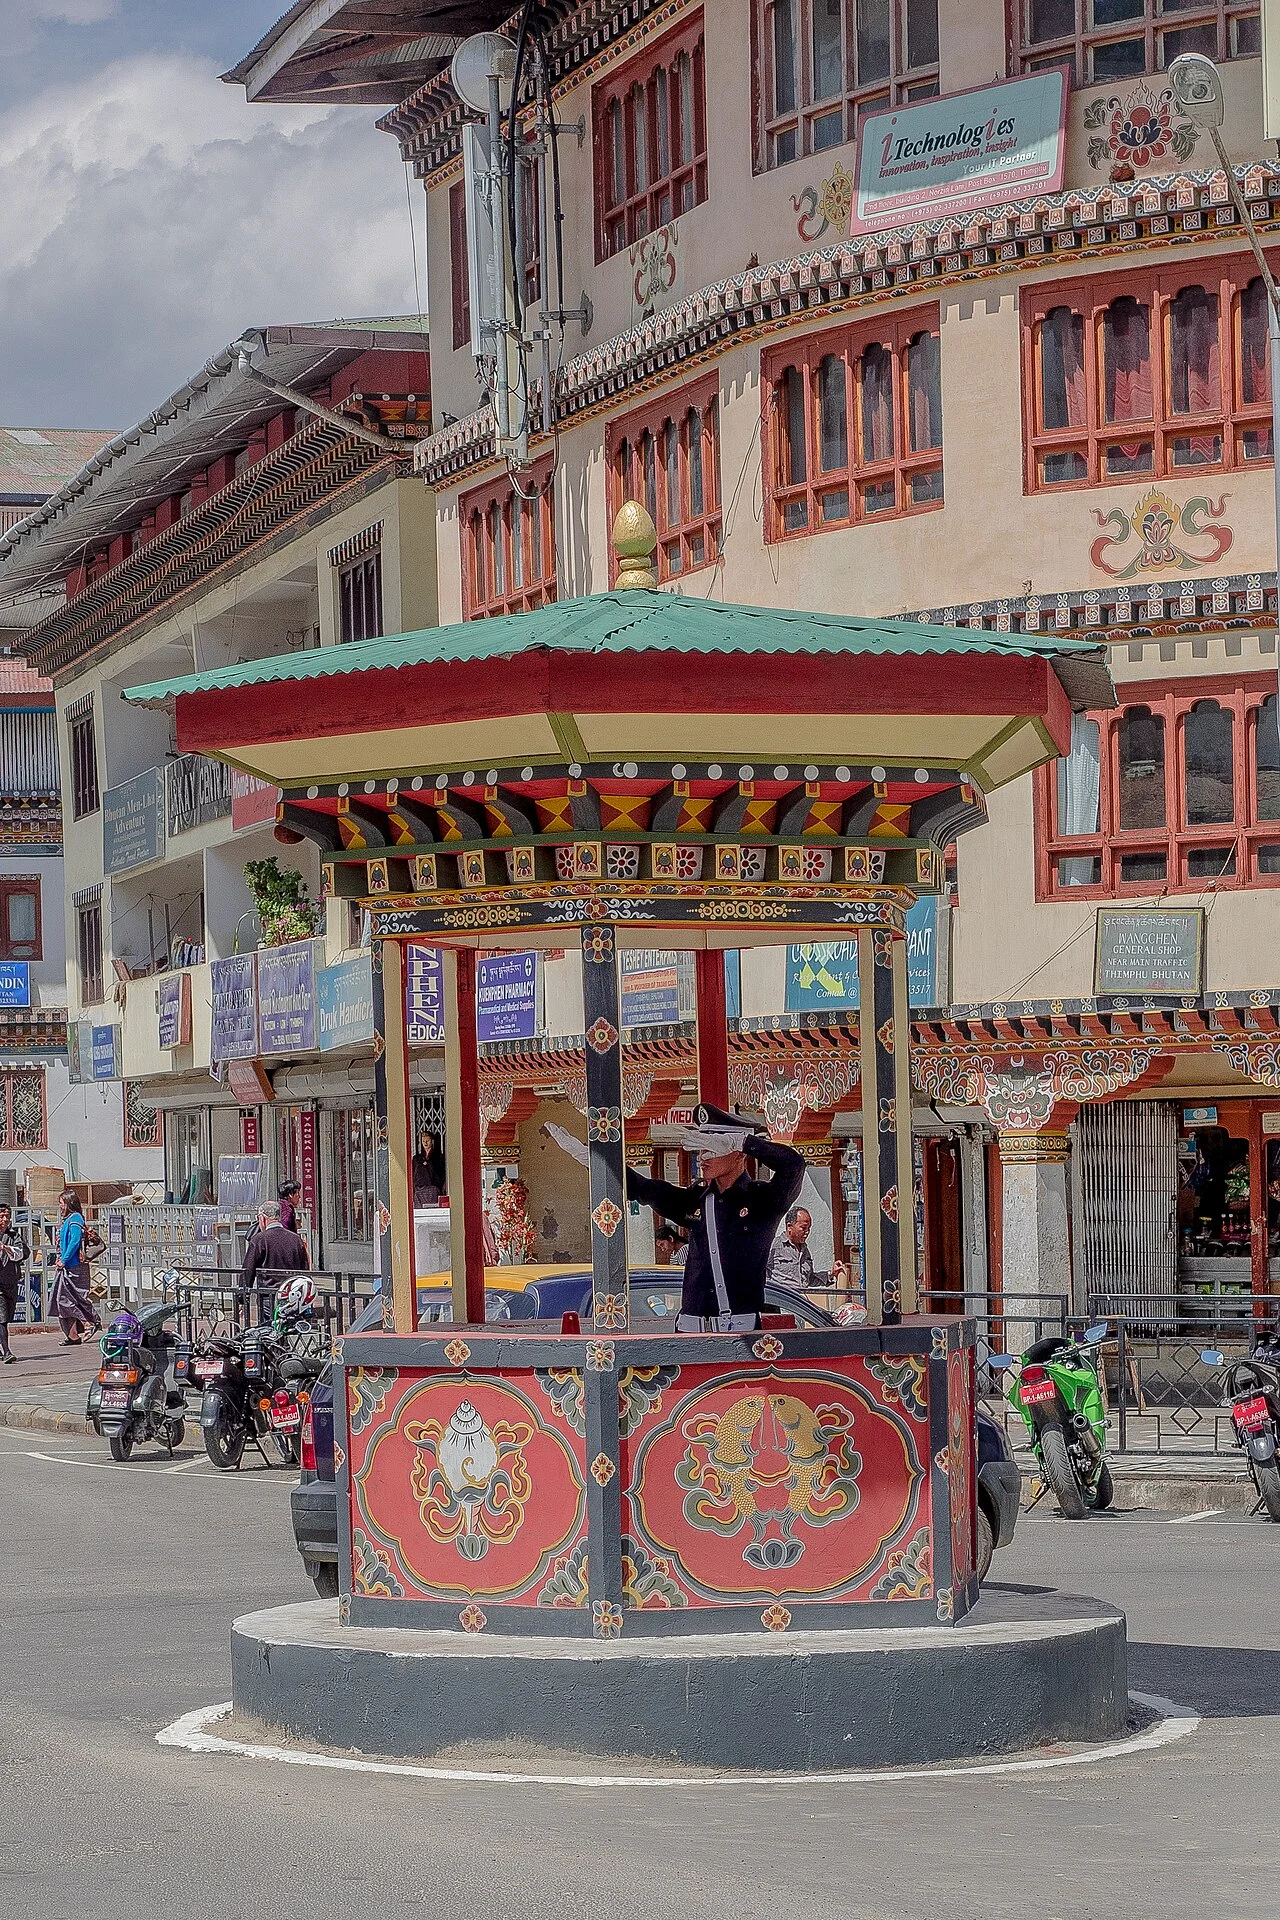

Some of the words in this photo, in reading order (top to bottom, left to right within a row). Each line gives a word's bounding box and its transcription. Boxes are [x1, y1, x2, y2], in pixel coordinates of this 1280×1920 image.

[985, 137, 1018, 153] insight
[963, 163, 986, 175] Your
[988, 157, 998, 169] IT
[1000, 151, 1038, 166] Partner
[113, 814, 145, 836] Adventure
[1118, 932, 1178, 945] WANGCHEN
[1113, 945, 1156, 955] GENERAL
[1157, 945, 1182, 955] SHOP
[1107, 958, 1128, 966] NEAR
[1129, 958, 1150, 966] MAIN
[1152, 958, 1188, 966] TRAFFIC
[1105, 969, 1148, 979] THIMPHU
[1151, 970, 1190, 979] BHUTAN
[505, 980, 535, 1000] PHARMACY
[909, 984, 931, 995] 3517
[320, 1005, 338, 1033] Druk
[670, 1110, 694, 1124] MED
[247, 1122, 255, 1147] PURE
